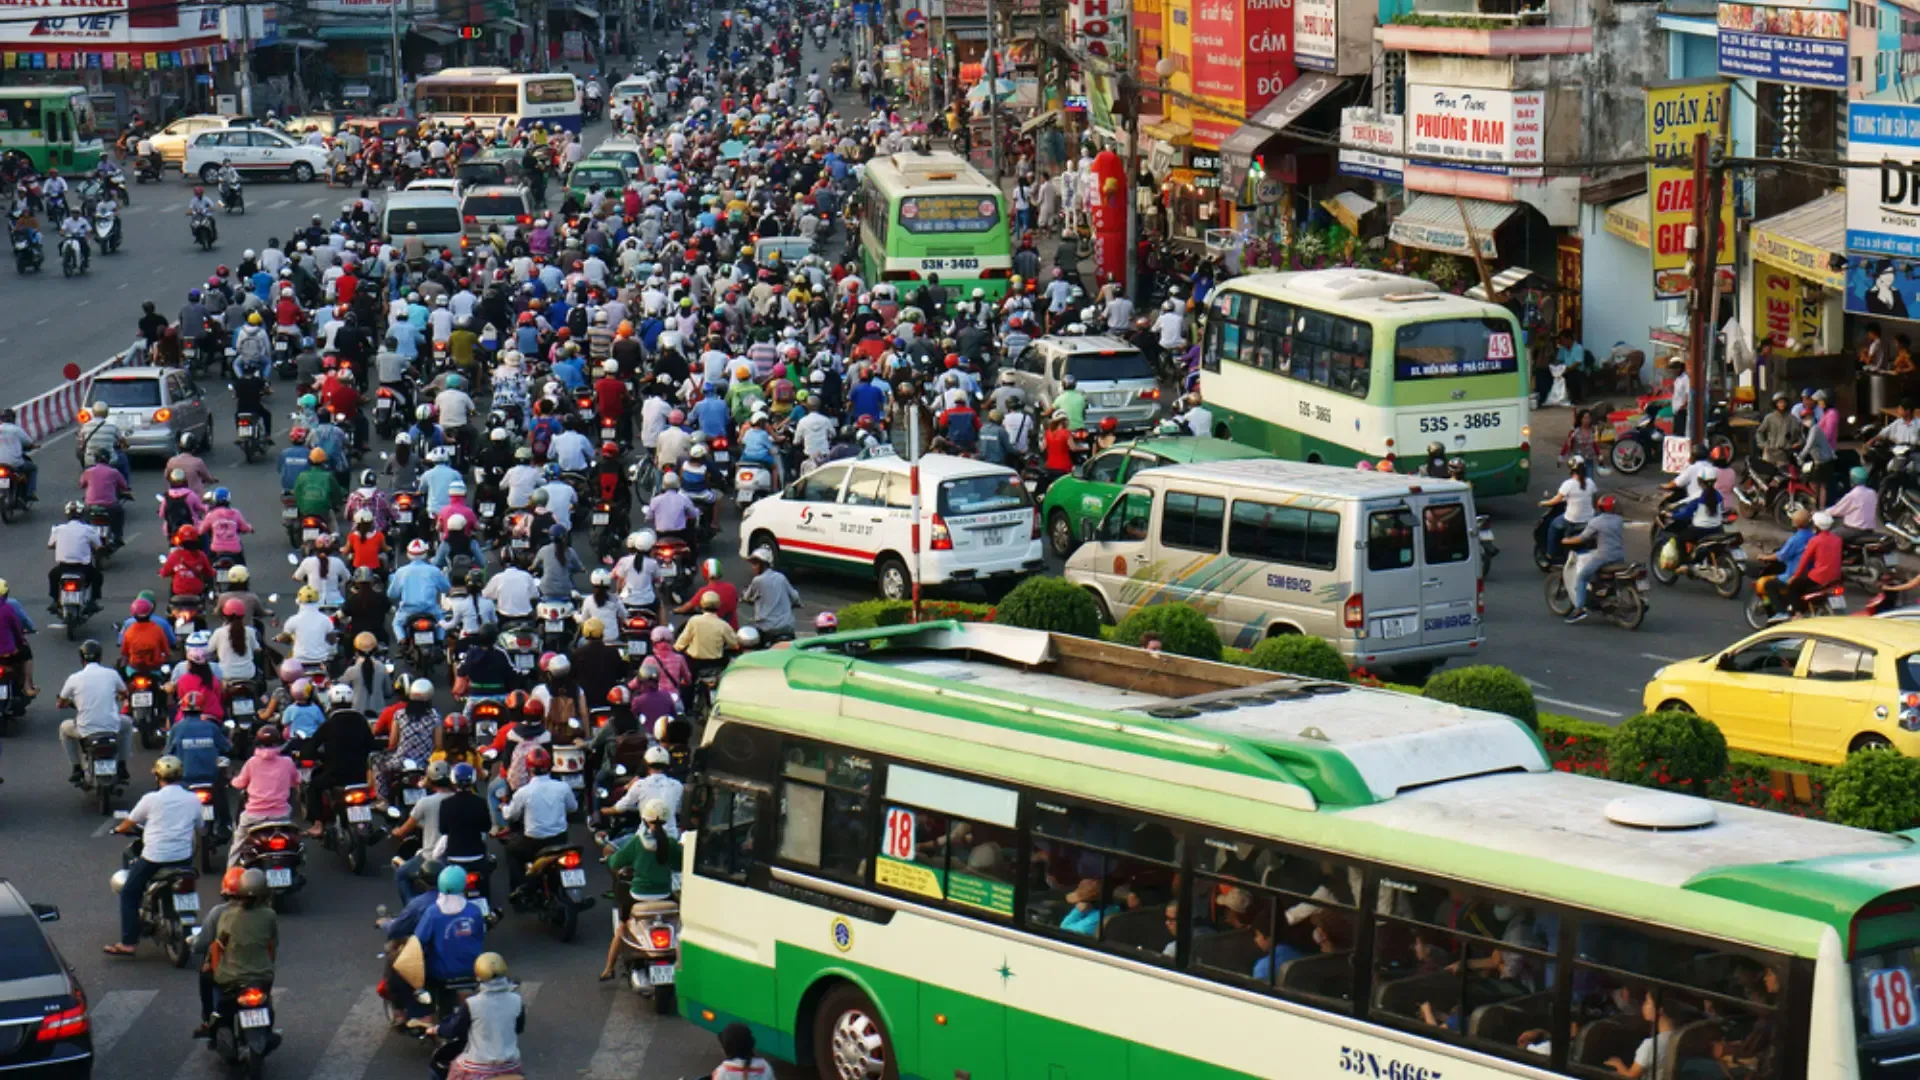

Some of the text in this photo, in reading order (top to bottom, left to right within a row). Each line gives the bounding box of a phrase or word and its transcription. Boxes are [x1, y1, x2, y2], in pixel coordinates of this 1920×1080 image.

[457, 26, 483, 39] LED
[1434, 92, 1457, 109] Hoa
[1653, 93, 1699, 135] QUÁN
[1416, 112, 1505, 145] PHƯƠNG NAM
[1490, 334, 1511, 357] 43
[888, 809, 912, 858] 18
[1874, 970, 1911, 1032] 18
